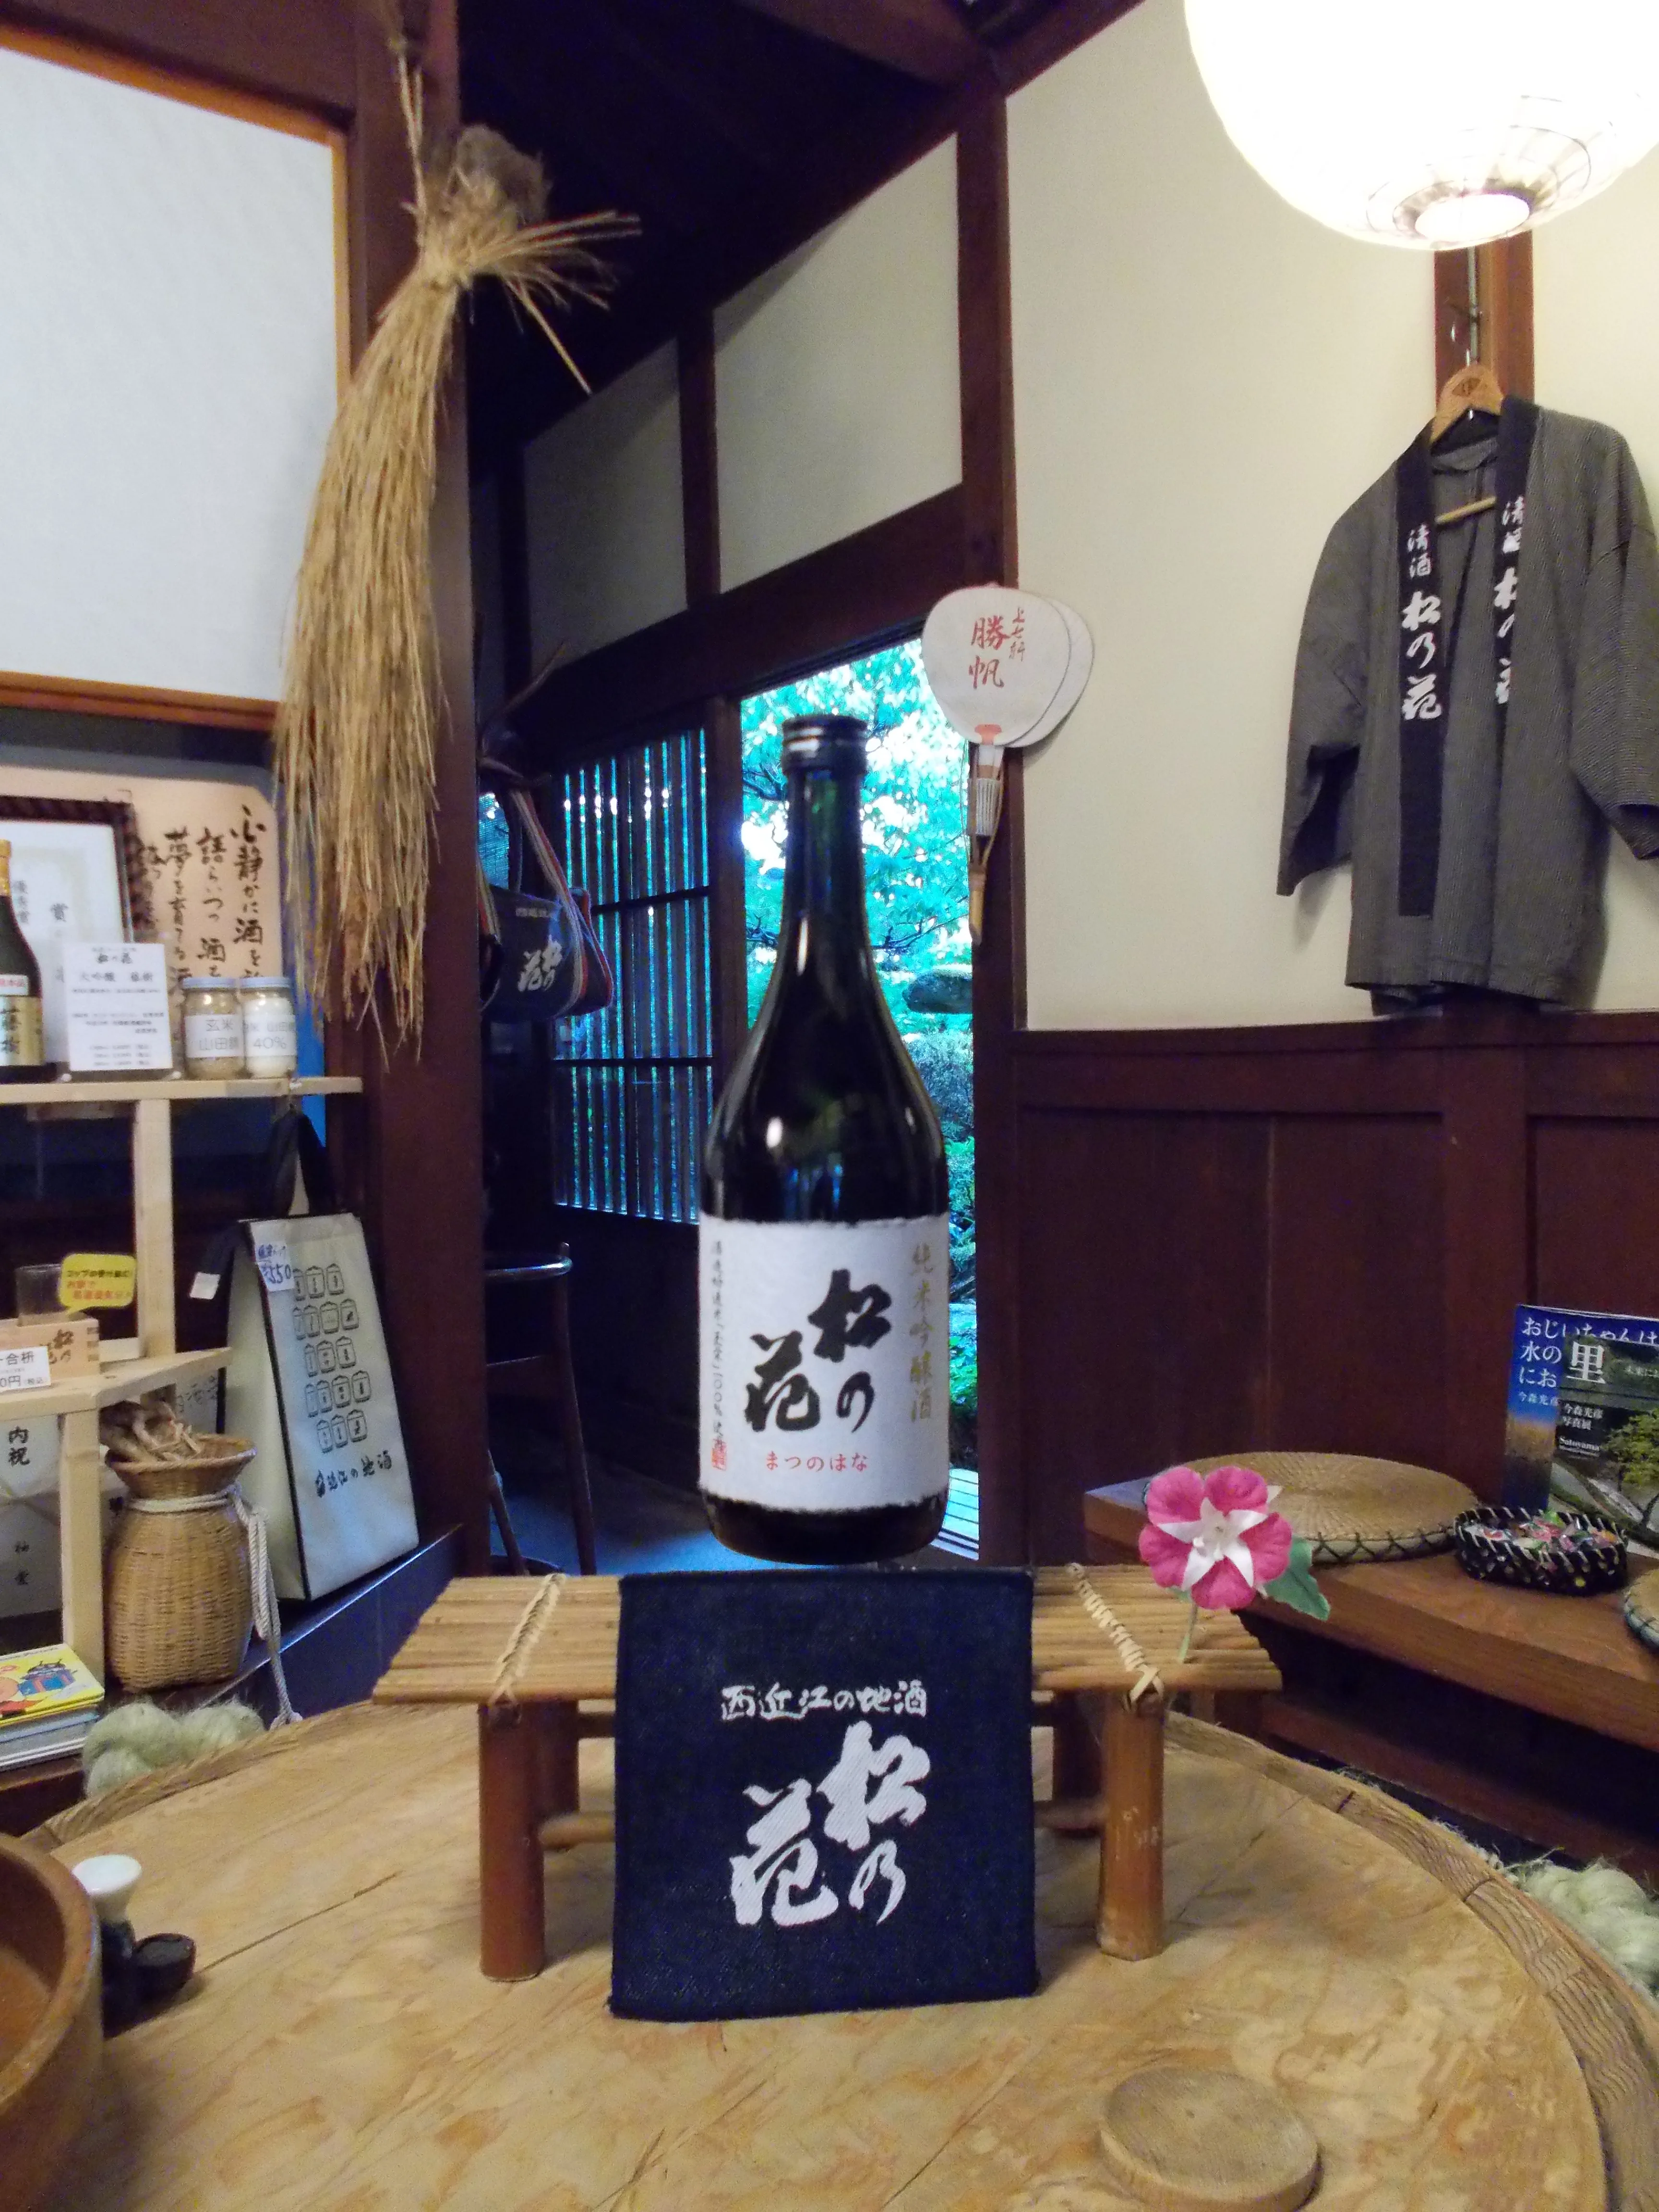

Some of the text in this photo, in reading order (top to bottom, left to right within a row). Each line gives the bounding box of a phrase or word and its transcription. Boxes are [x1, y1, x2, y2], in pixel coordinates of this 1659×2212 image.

[1407, 523, 1433, 579] 清酒
[205, 1017, 233, 1032] 玄米
[1520, 1341, 1562, 1364] 水の
[1566, 1341, 1607, 1384] 里
[1519, 1366, 1557, 1388] にお
[8, 1425, 30, 1467] 内祝
[766, 1450, 869, 1472] まつのはな
[721, 1679, 927, 1722] 西近江の地酒
